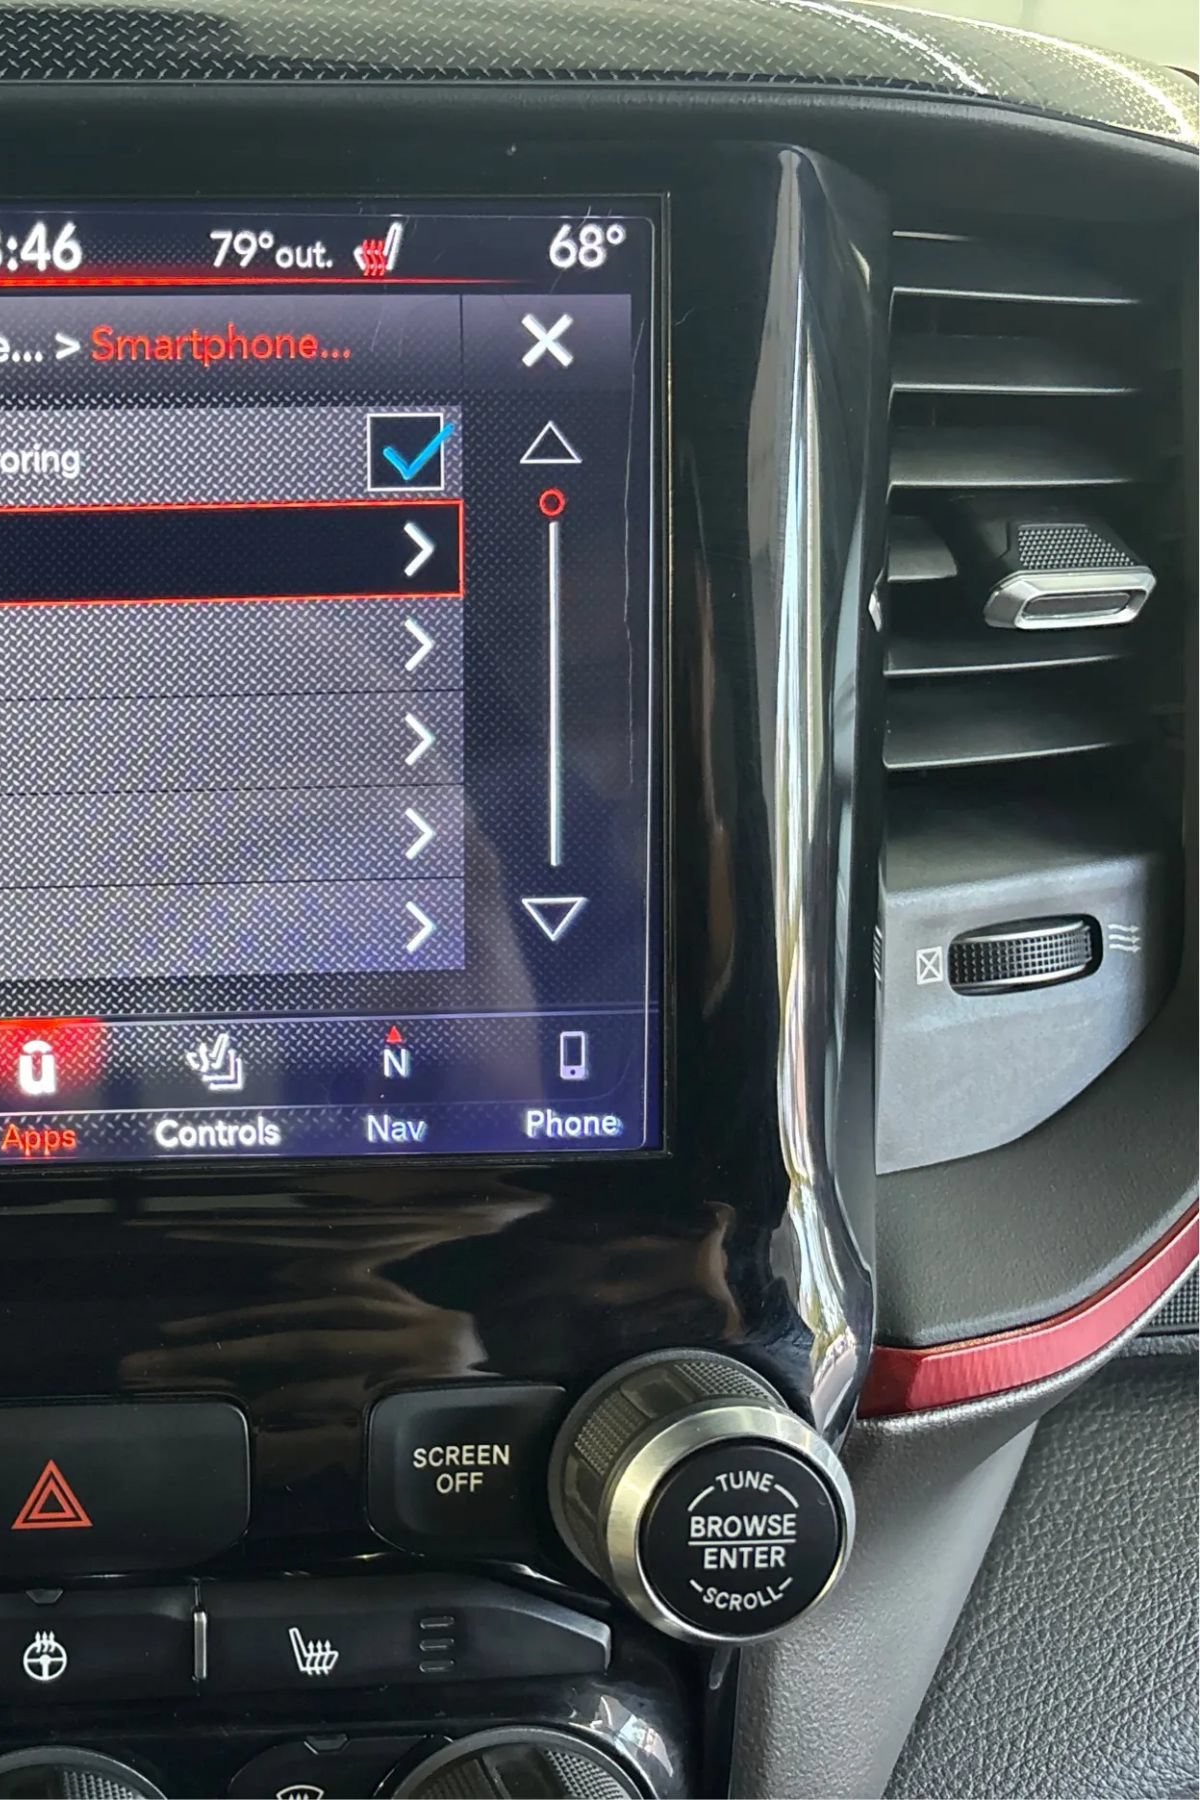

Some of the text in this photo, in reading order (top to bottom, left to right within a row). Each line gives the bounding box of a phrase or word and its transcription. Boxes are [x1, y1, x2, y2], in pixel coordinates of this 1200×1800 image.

[548, 223, 626, 269] 68°
[90, 321, 351, 368] Smartphone...
[383, 1049, 409, 1078] N
[155, 1118, 281, 1149] Controls
[366, 1113, 425, 1143] Nav
[524, 1107, 620, 1138] Phone
[1, 1123, 78, 1157] Apps
[412, 1443, 510, 1470] SCREEN
[436, 1473, 484, 1495] OFF
[715, 1471, 774, 1495] TUNE
[688, 1513, 797, 1539] BROWSE
[703, 1544, 785, 1571] ENTER
[702, 1584, 784, 1612] SCROLL
